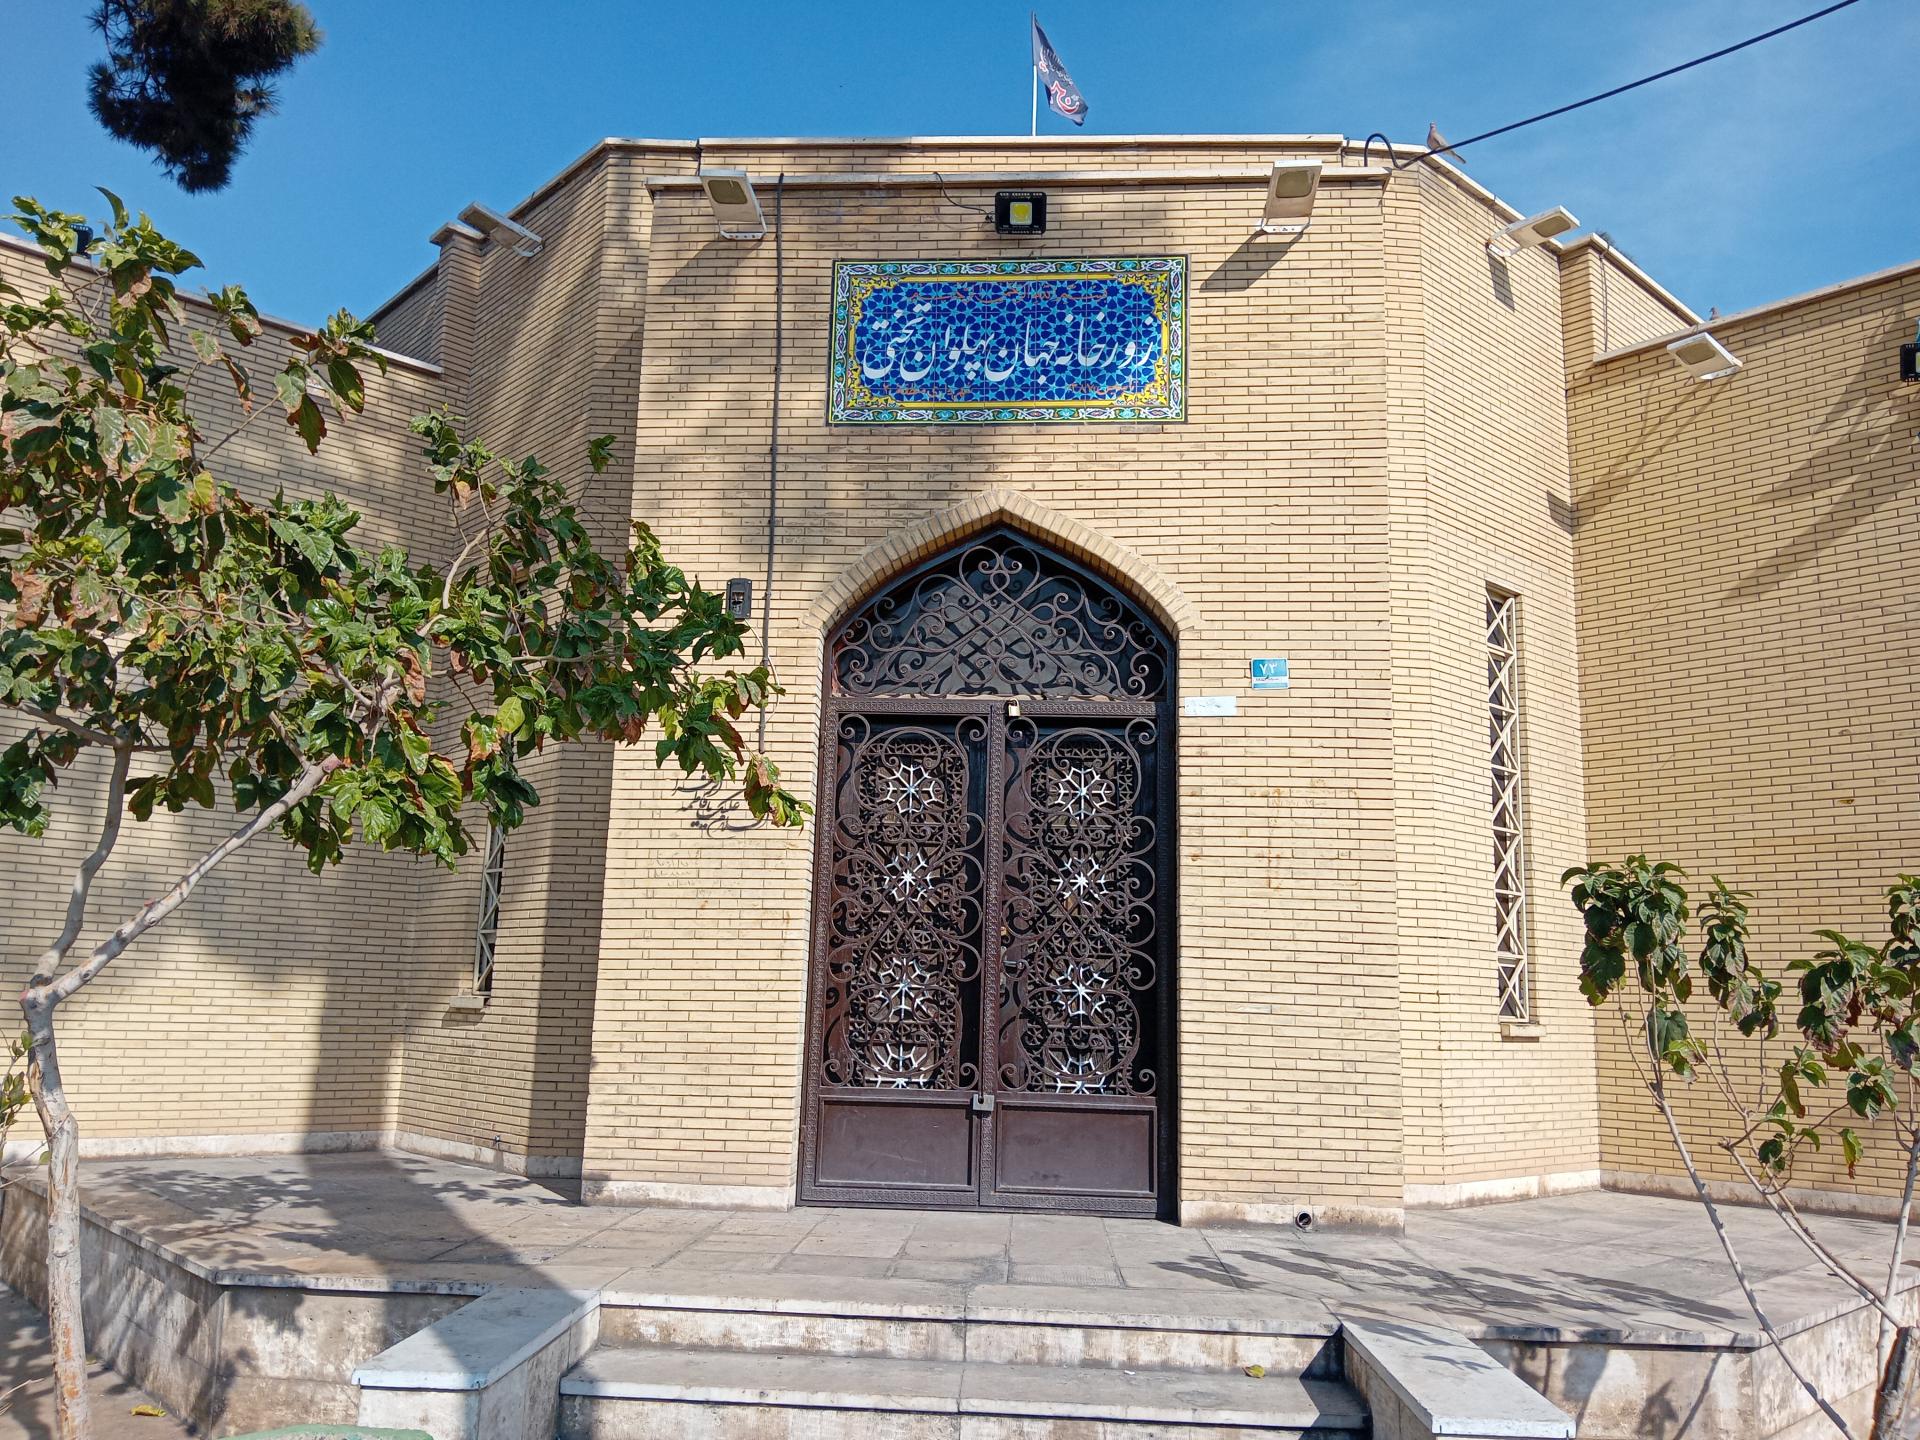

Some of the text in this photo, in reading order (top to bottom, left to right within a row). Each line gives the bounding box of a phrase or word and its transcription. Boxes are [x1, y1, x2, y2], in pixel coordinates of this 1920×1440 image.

[863, 302, 932, 379] تختی
[900, 324, 995, 382] پهلوان
[984, 319, 1060, 385] جهان
[1259, 663, 1277, 675] ۷۳
